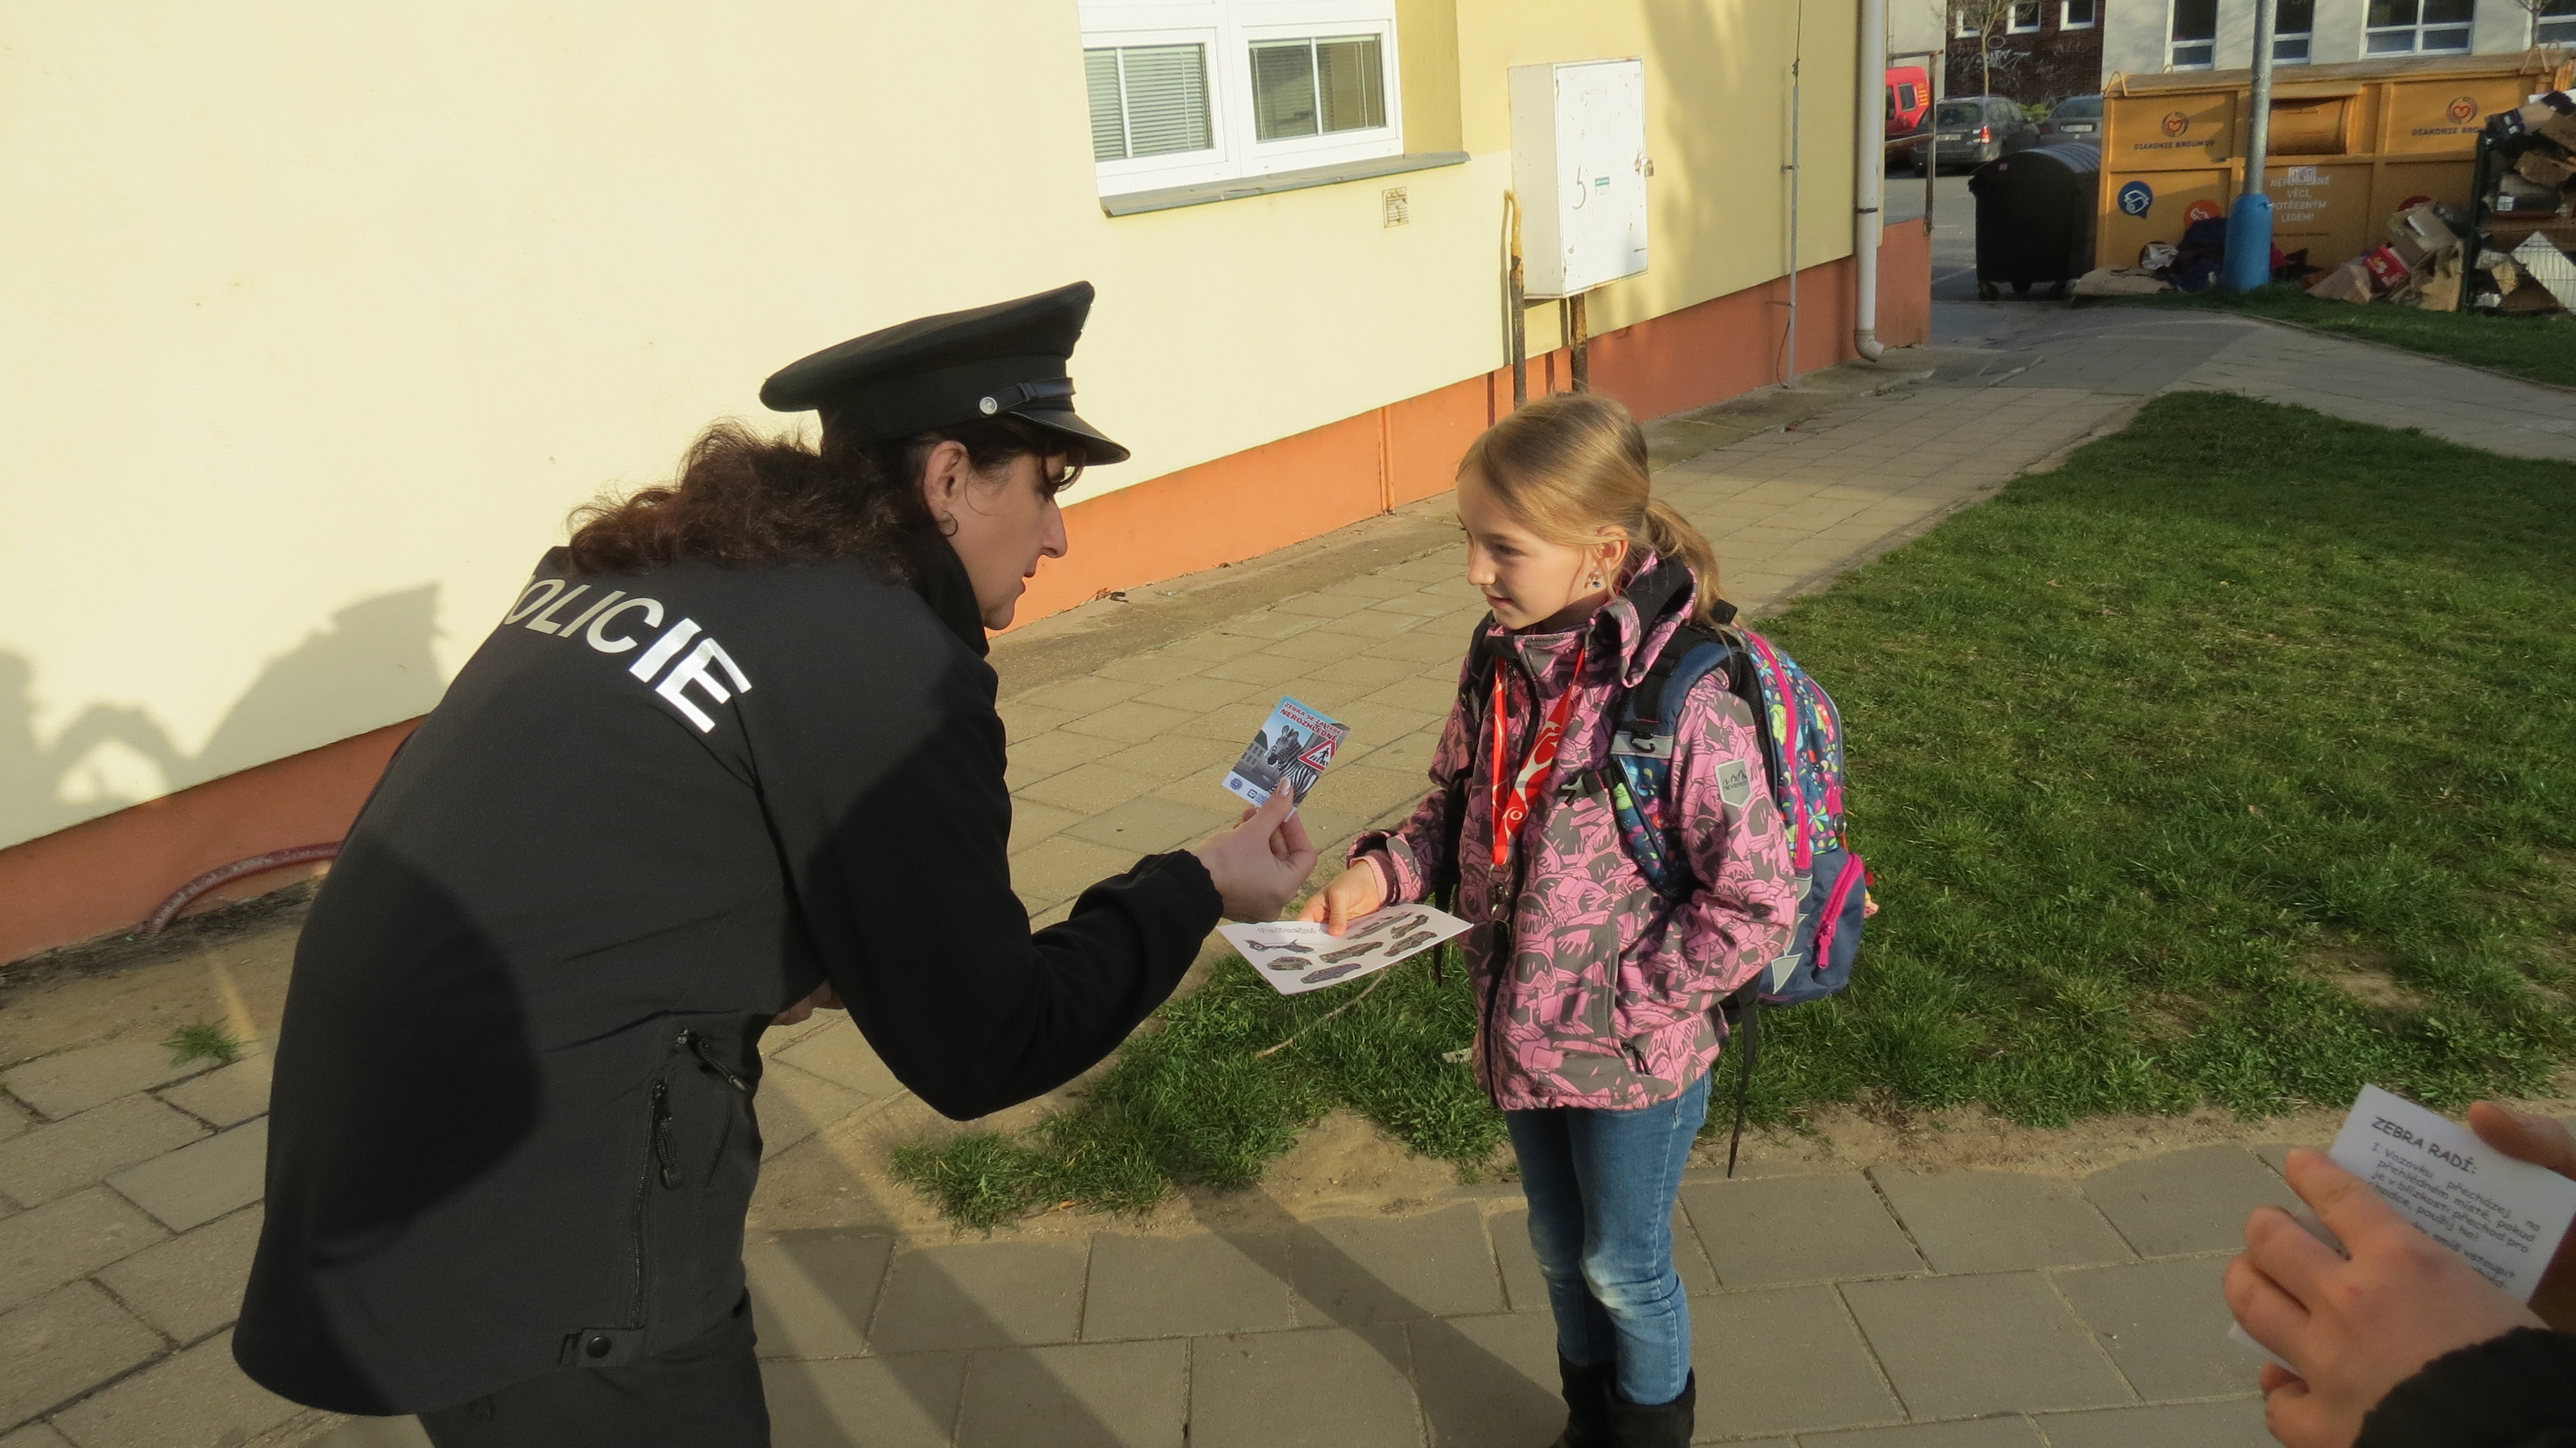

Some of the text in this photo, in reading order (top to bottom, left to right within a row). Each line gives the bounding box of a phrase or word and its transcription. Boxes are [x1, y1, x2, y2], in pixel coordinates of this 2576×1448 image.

[2134, 142, 2174, 151] DIAKONIE
[2412, 128, 2457, 136] DIAKONIE
[504, 576, 752, 734] OLICIE
[1285, 702, 1305, 717] ZEBRA
[1327, 725, 1342, 734] TEBE
[2371, 1116, 2477, 1174] ZEBRA RADÍ:
[2385, 1148, 2434, 1179] Vozovku
[2447, 1181, 2512, 1219] přecházej
[2526, 1220, 2541, 1233] na
[2371, 1170, 2385, 1181] je
[2397, 1181, 2451, 1212] blízkosti
[2453, 1211, 2506, 1241] přechod
[2506, 1238, 2529, 1253] pro
[2418, 1206, 2454, 1231] použij
[2497, 1220, 2536, 1242] pokud
[2463, 1249, 2515, 1279] vstoupit
